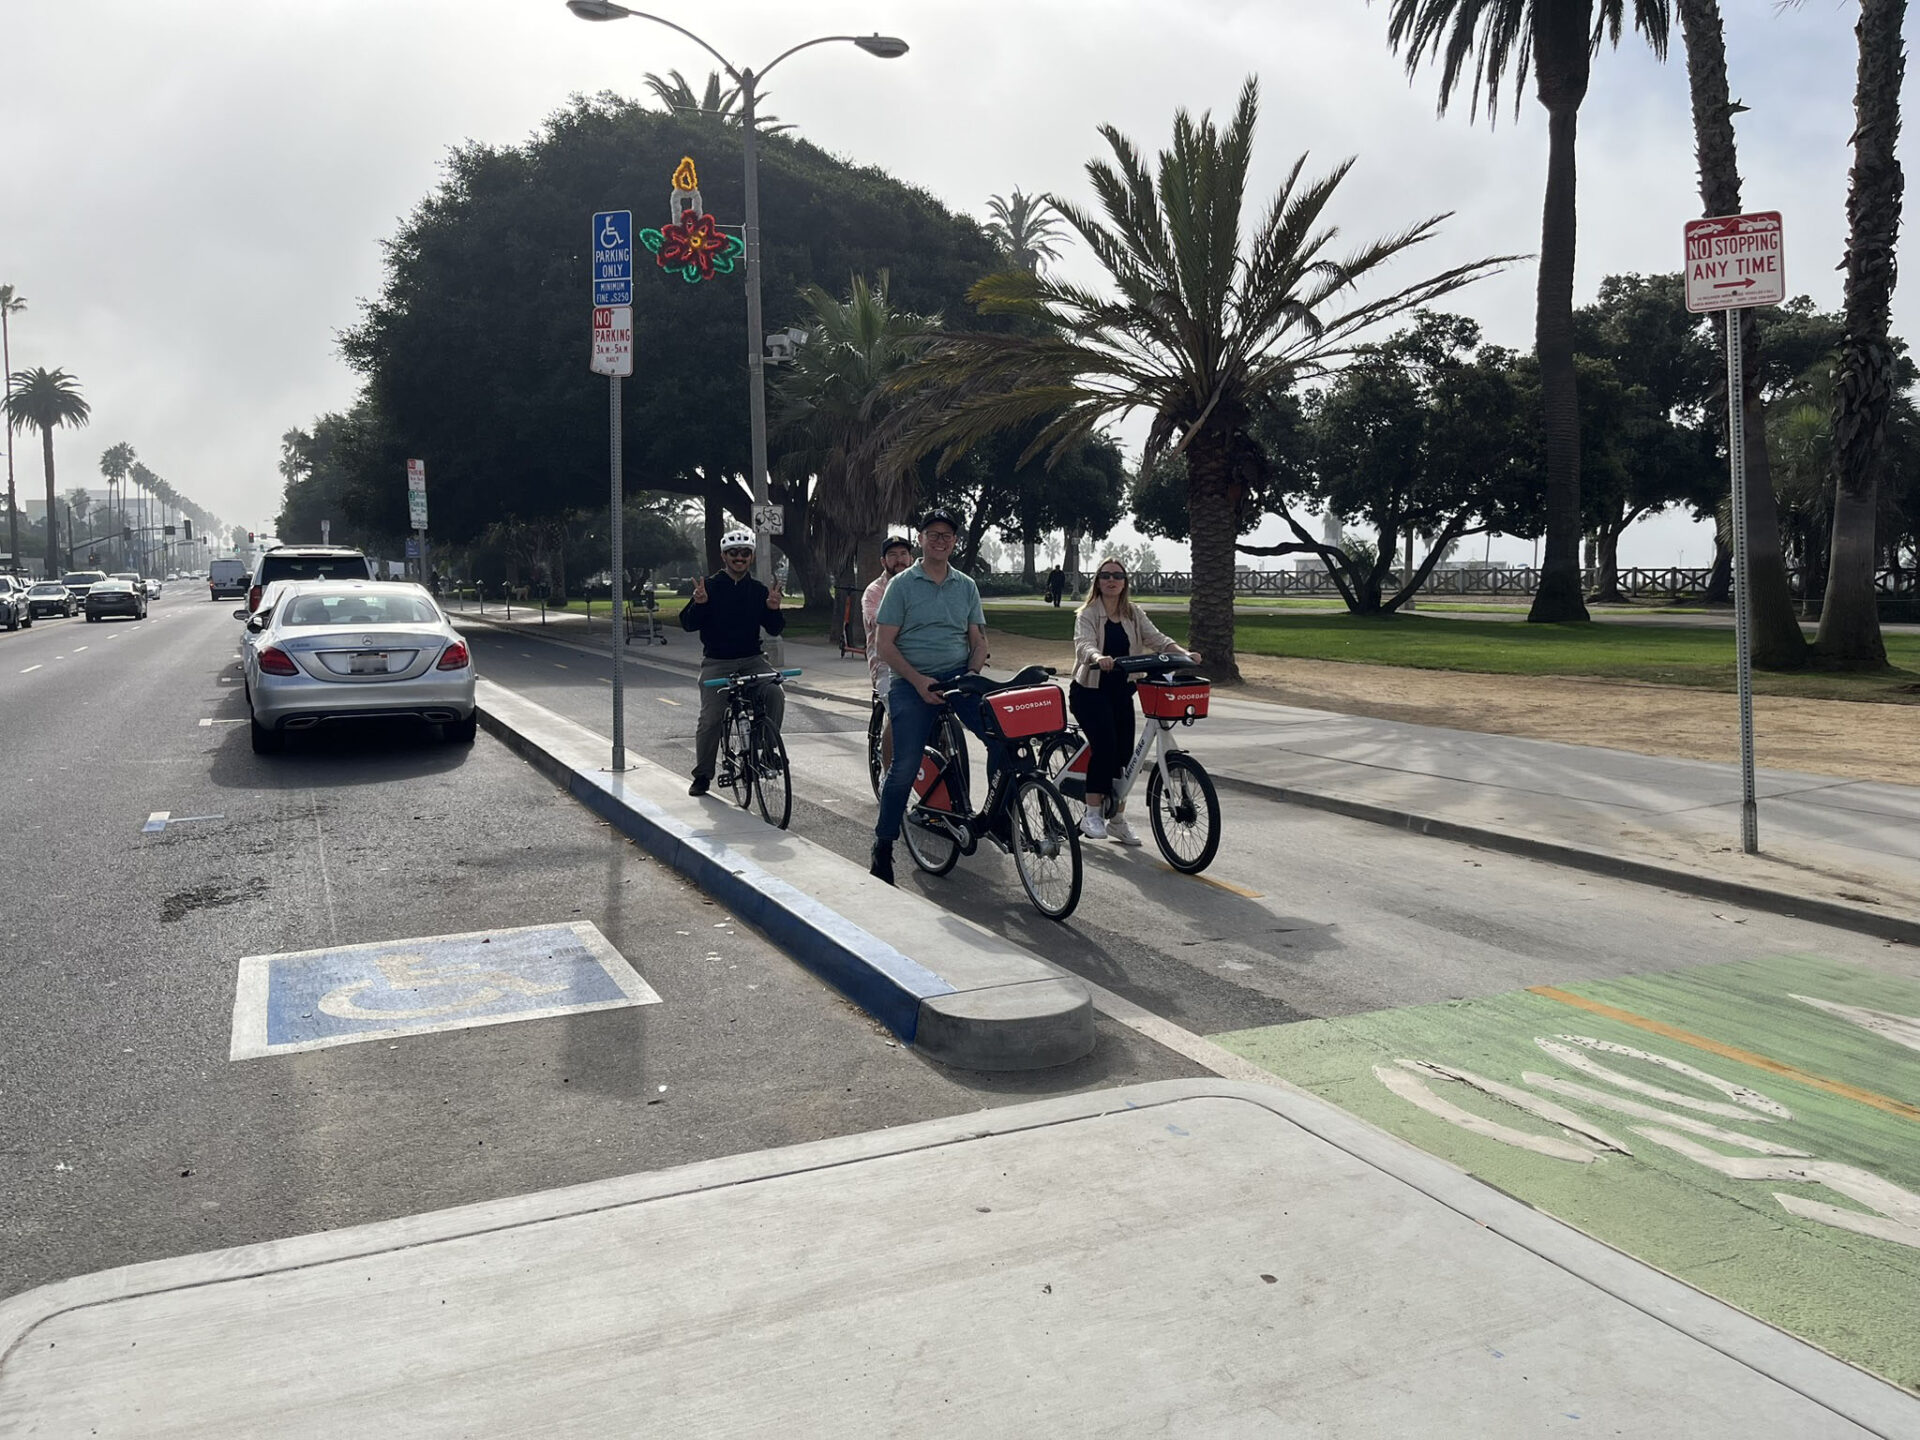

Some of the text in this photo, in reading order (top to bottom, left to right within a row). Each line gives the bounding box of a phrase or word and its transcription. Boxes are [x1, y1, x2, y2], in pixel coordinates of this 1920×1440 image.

[1689, 233, 1778, 260] NO STOPPING
[595, 248, 630, 263] PARKING
[602, 264, 623, 278] ONLY
[1693, 255, 1777, 281] ANY TIME
[600, 282, 625, 292] MINIMUM
[596, 294, 609, 303] FINE
[596, 310, 610, 327] NO
[595, 328, 630, 343] PARKING
[1015, 700, 1052, 711] DOORDASH
[1135, 739, 1145, 757] Bike
[983, 769, 1002, 816] Metro Bike
